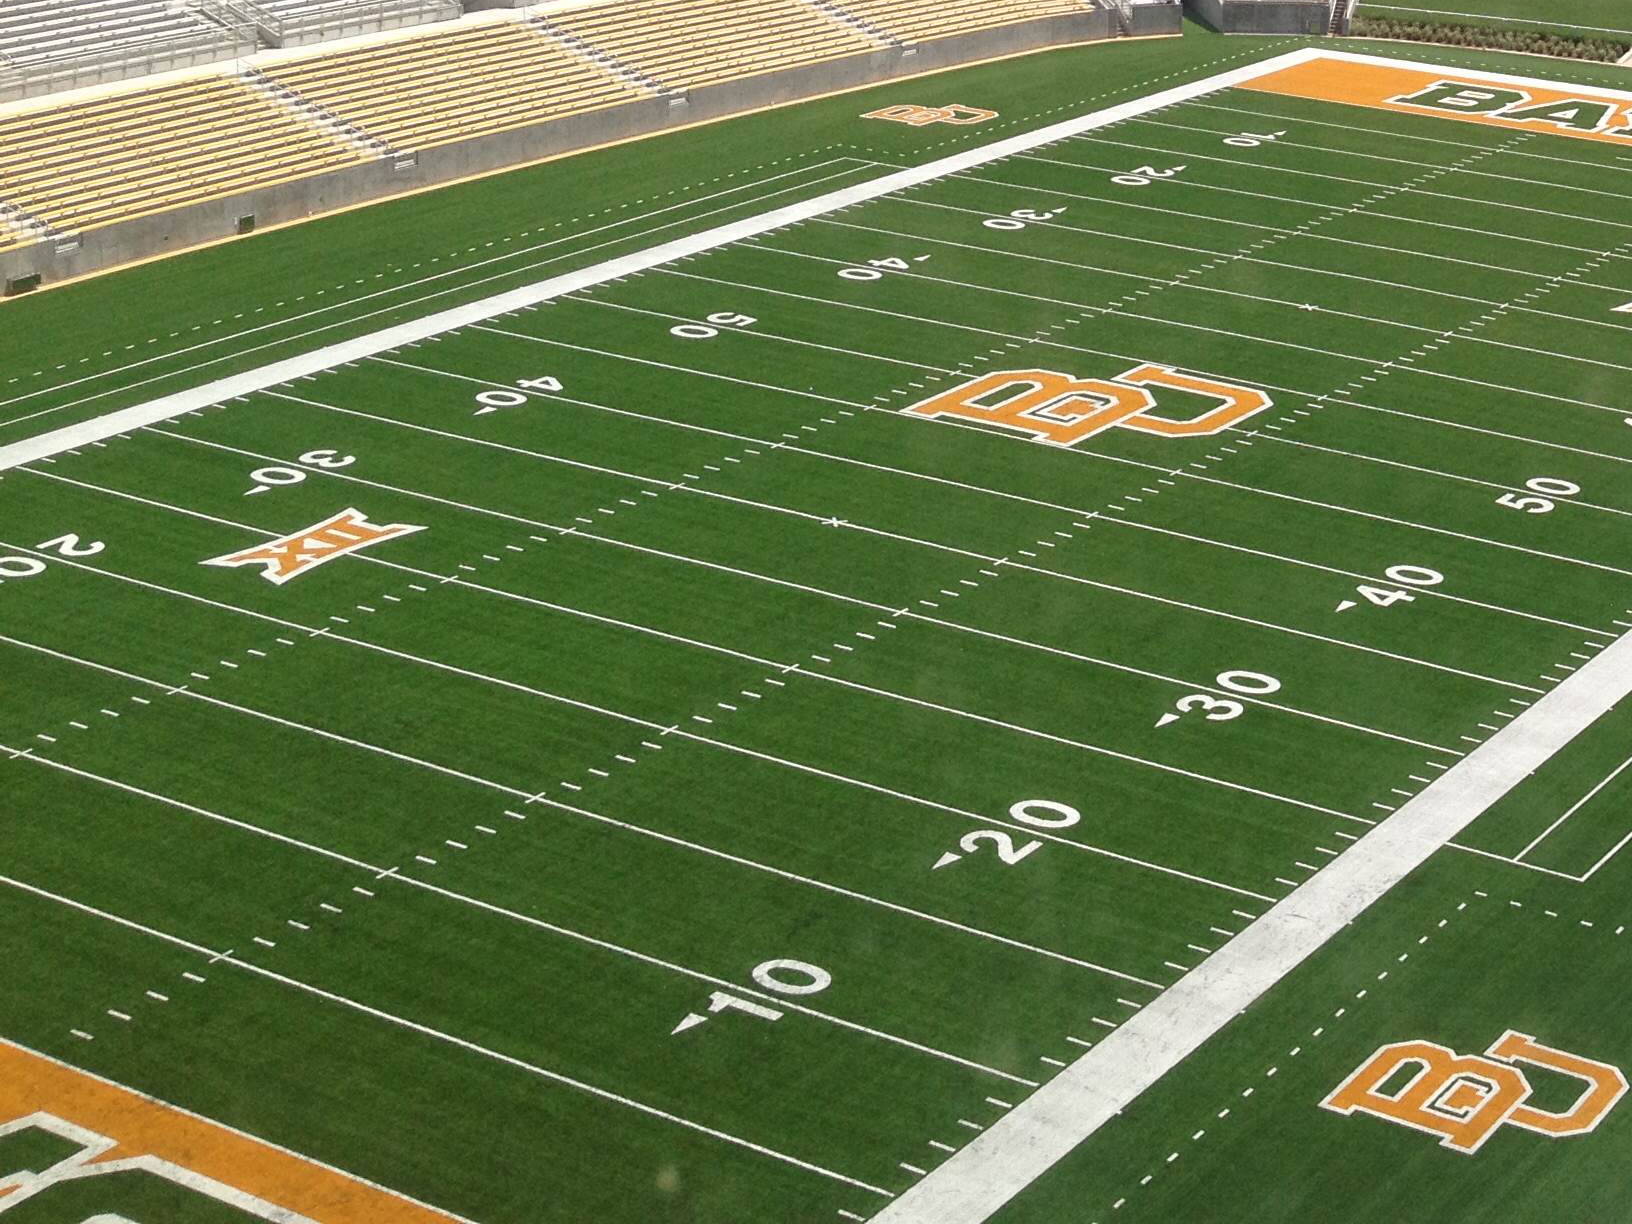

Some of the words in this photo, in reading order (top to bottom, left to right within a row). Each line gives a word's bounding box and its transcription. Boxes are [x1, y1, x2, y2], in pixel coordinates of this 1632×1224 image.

[1223, 131, 1276, 147] 10
[1111, 165, 1174, 186] 20
[983, 209, 1054, 230] 30
[837, 255, 909, 281] 40
[670, 312, 757, 338] 50
[475, 376, 563, 406] 40
[250, 450, 356, 485] 30
[1495, 477, 1581, 514] 50
[0, 533, 105, 577] 20
[1357, 565, 1444, 610] 40
[1176, 670, 1281, 722] 30
[959, 799, 1081, 866] 20
[708, 959, 831, 1021] 10
